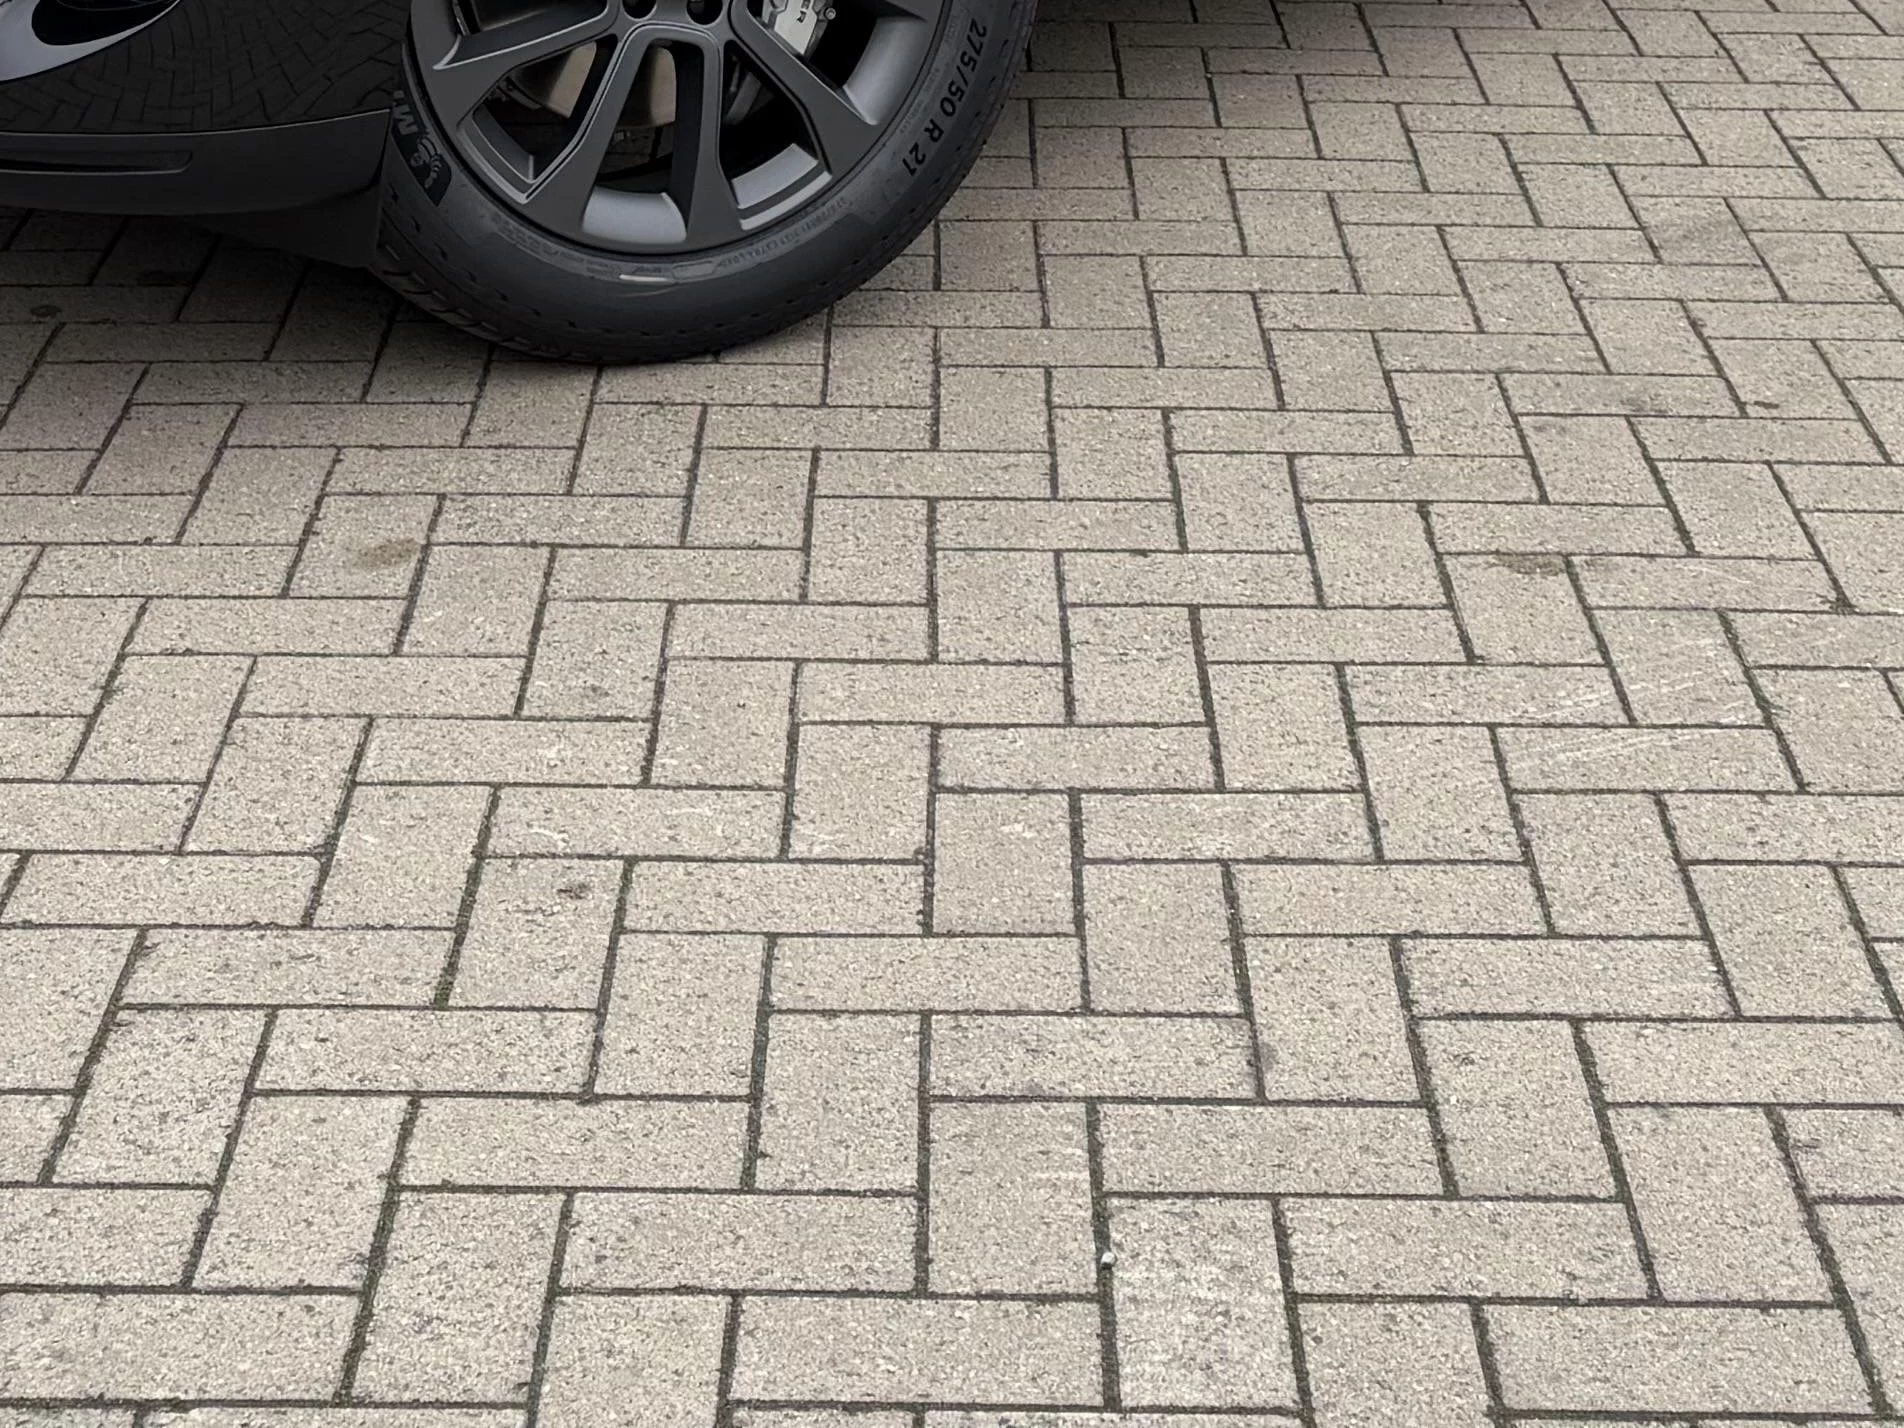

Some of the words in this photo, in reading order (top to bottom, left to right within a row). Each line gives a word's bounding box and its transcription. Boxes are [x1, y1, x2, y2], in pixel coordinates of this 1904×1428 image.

[939, 17, 988, 118] 275/50
[924, 118, 945, 142] R
[902, 142, 927, 177] 21
